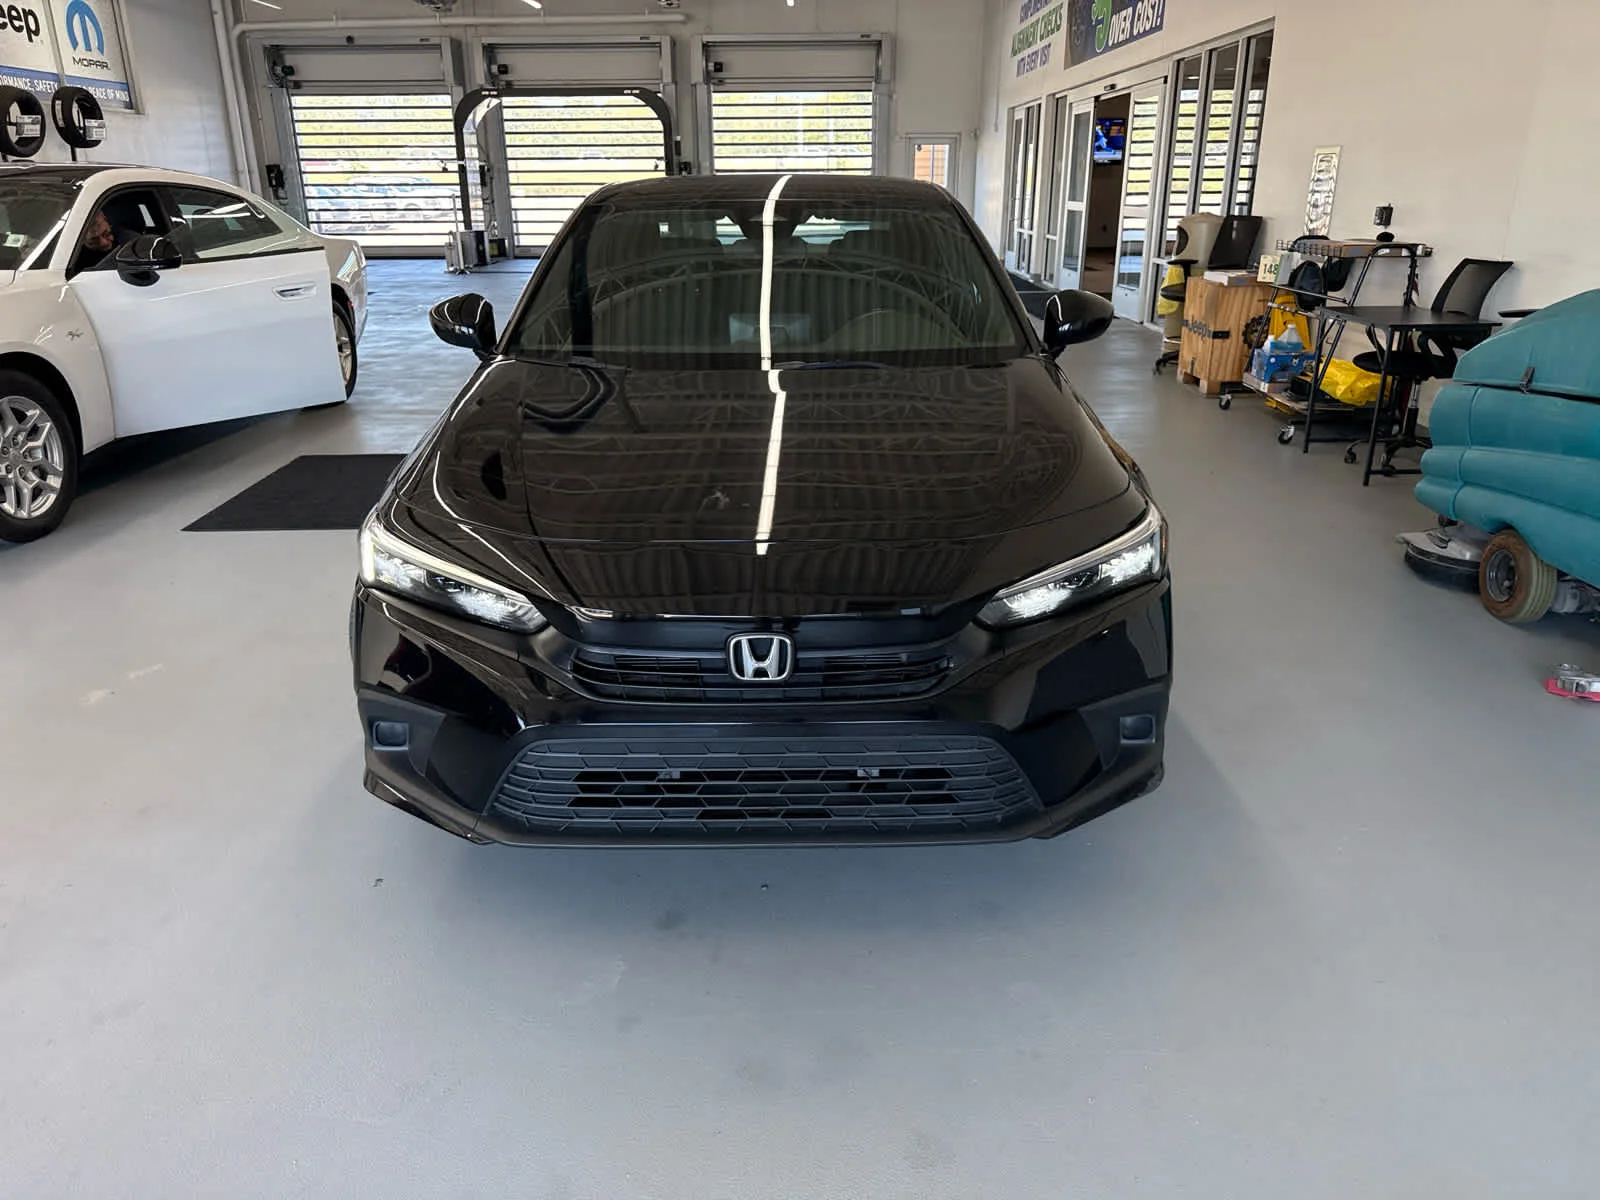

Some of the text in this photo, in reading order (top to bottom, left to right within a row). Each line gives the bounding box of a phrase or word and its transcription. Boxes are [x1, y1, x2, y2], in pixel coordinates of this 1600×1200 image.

[1108, 0, 1164, 47] OVER COST!
[72, 56, 109, 70] MOPAR
[33, 79, 58, 93] SAFETY
